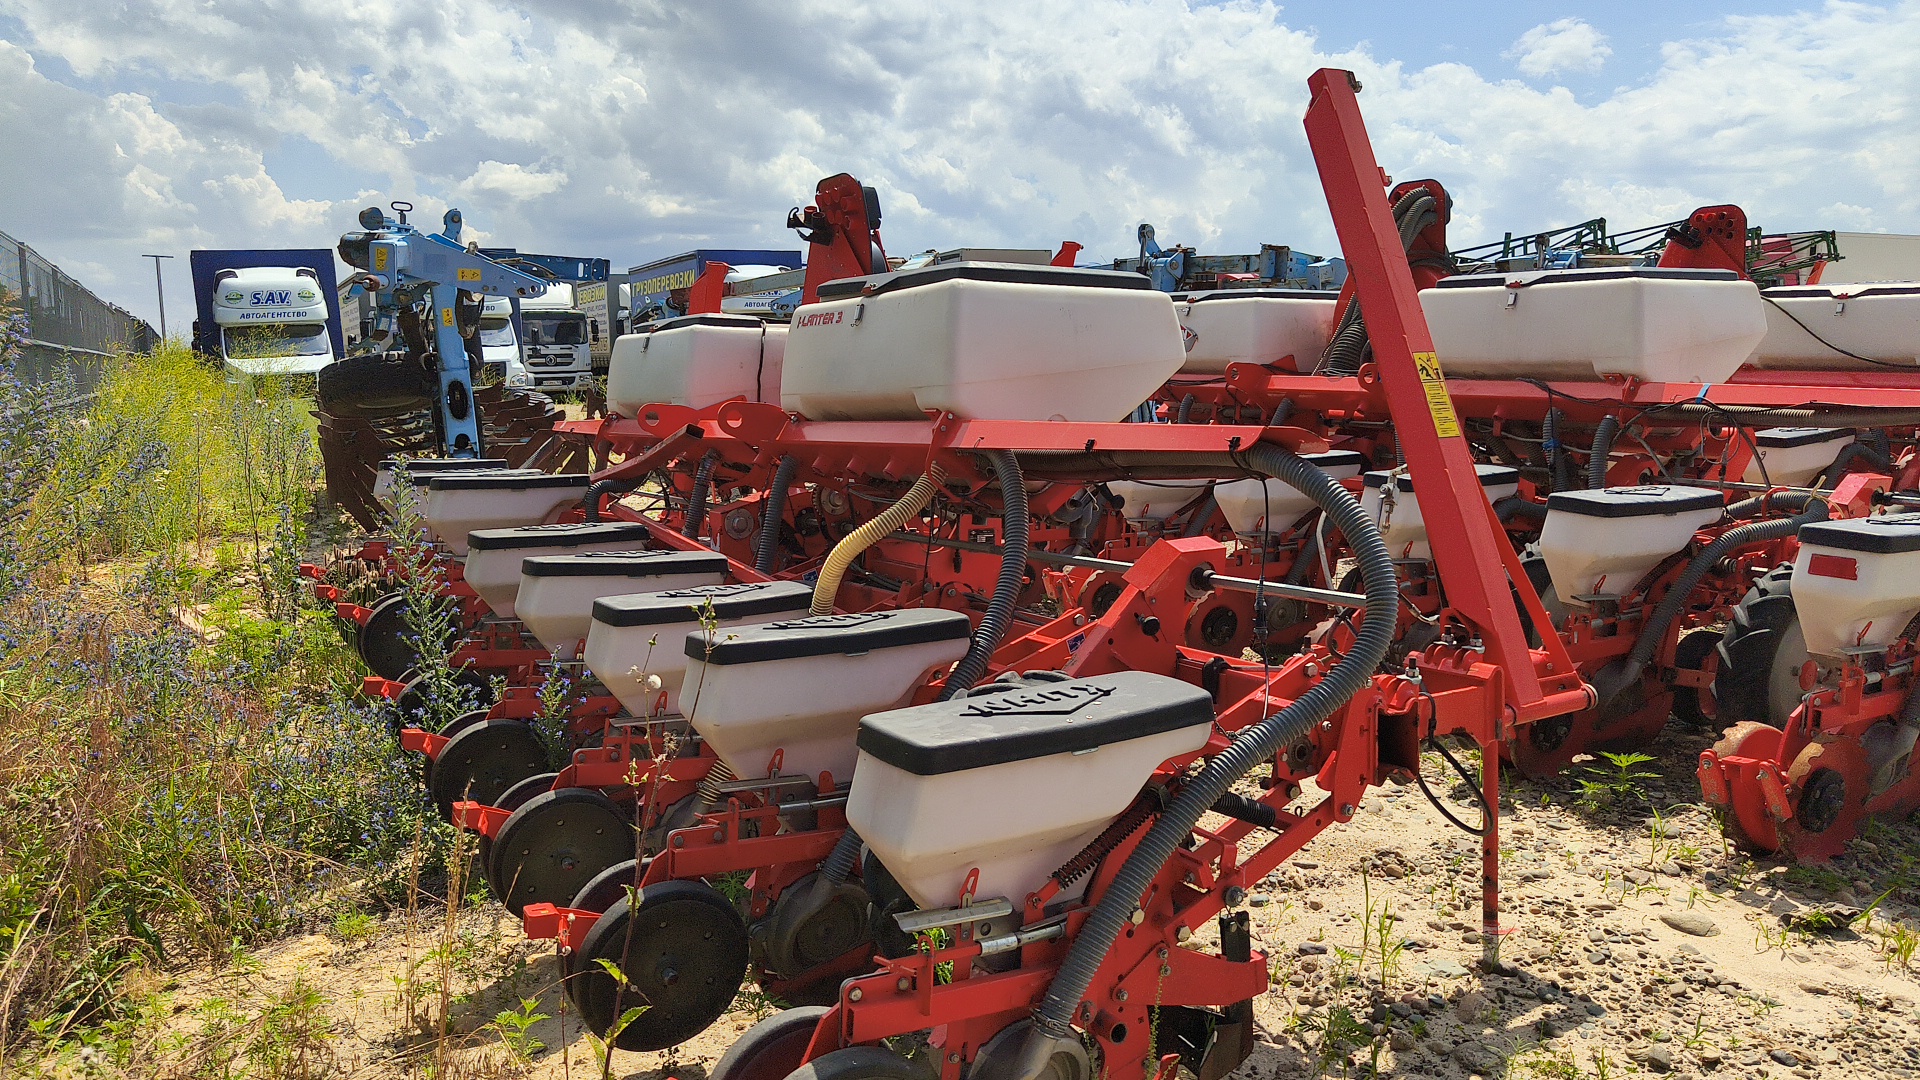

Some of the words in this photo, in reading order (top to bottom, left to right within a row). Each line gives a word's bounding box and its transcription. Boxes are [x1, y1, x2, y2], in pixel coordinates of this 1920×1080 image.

[632, 268, 696, 297] ГРУЗОПЕРЕВОЗКИ
[250, 290, 291, 306] S.A.V.
[239, 311, 308, 320] АВТОАГЕНТСТВО
[836, 311, 844, 324] 3
